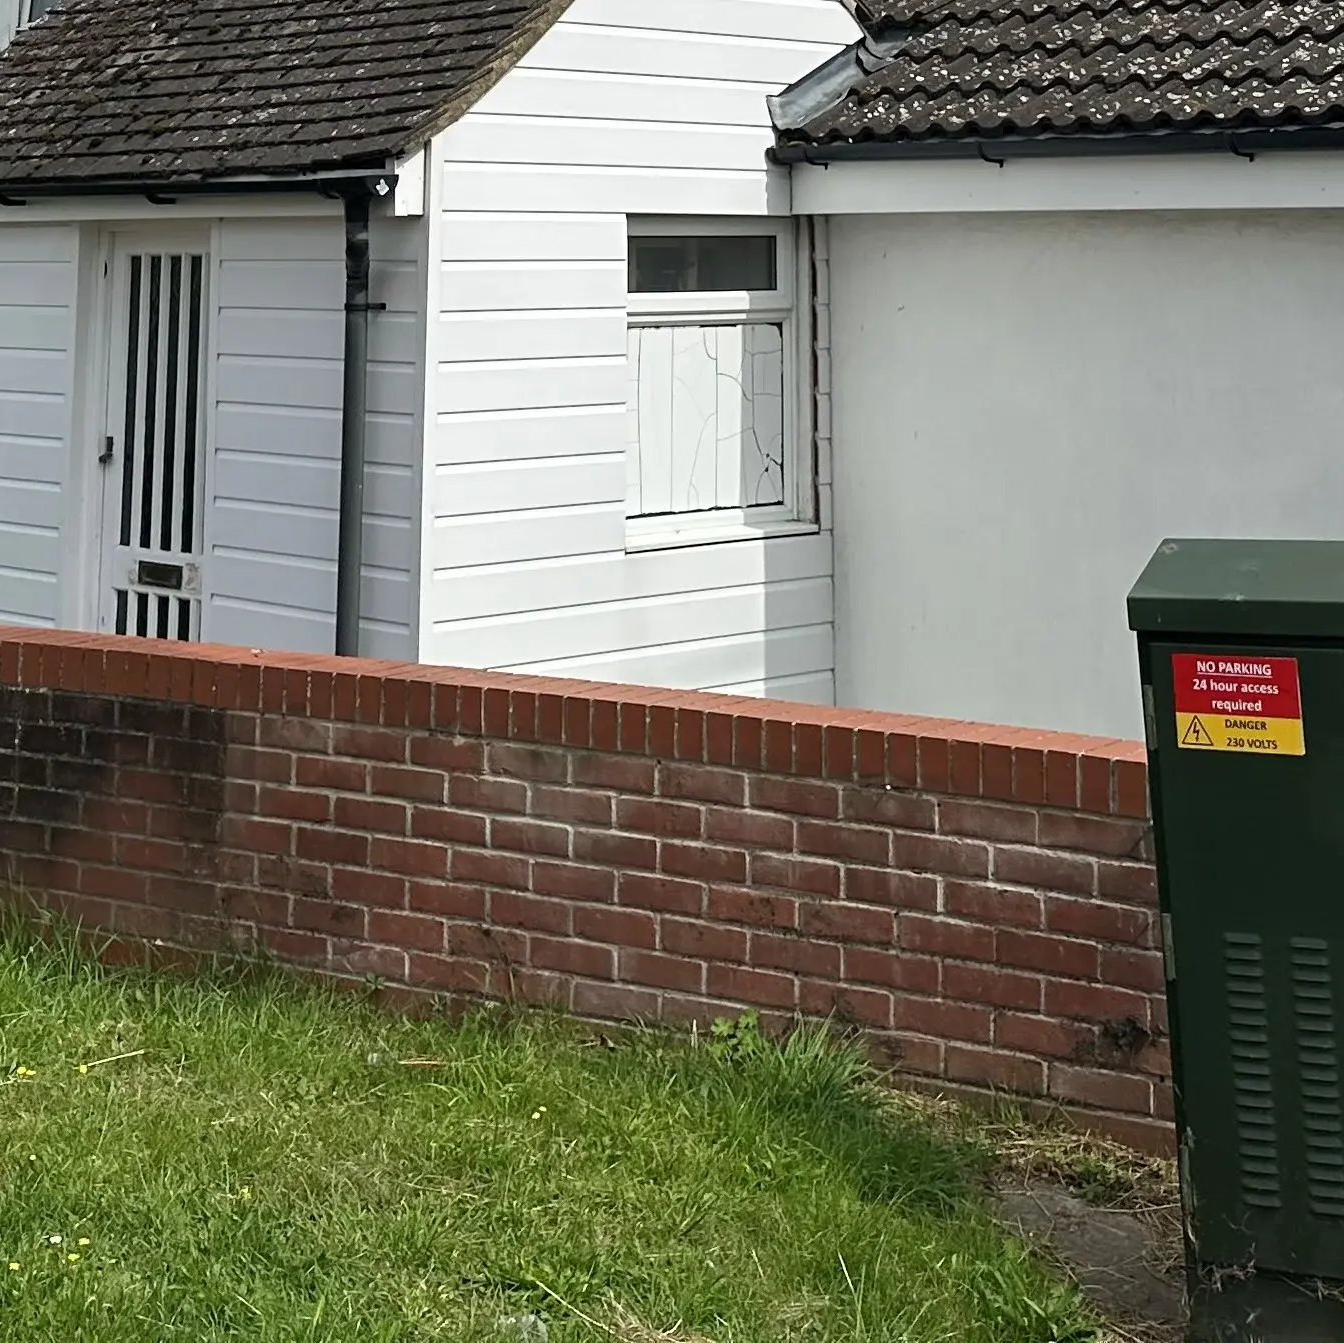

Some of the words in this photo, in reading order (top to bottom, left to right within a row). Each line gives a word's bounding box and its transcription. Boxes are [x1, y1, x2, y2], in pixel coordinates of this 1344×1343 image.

[1196, 660, 1216, 673] NO
[1218, 661, 1272, 676] PARKING
[1192, 678, 1207, 691] 24
[1210, 679, 1238, 693] hour
[1240, 682, 1279, 695] access
[1211, 698, 1263, 713] required
[1224, 718, 1267, 731] DANGER
[1226, 737, 1245, 748] 230
[1247, 738, 1278, 750] VOLTS
